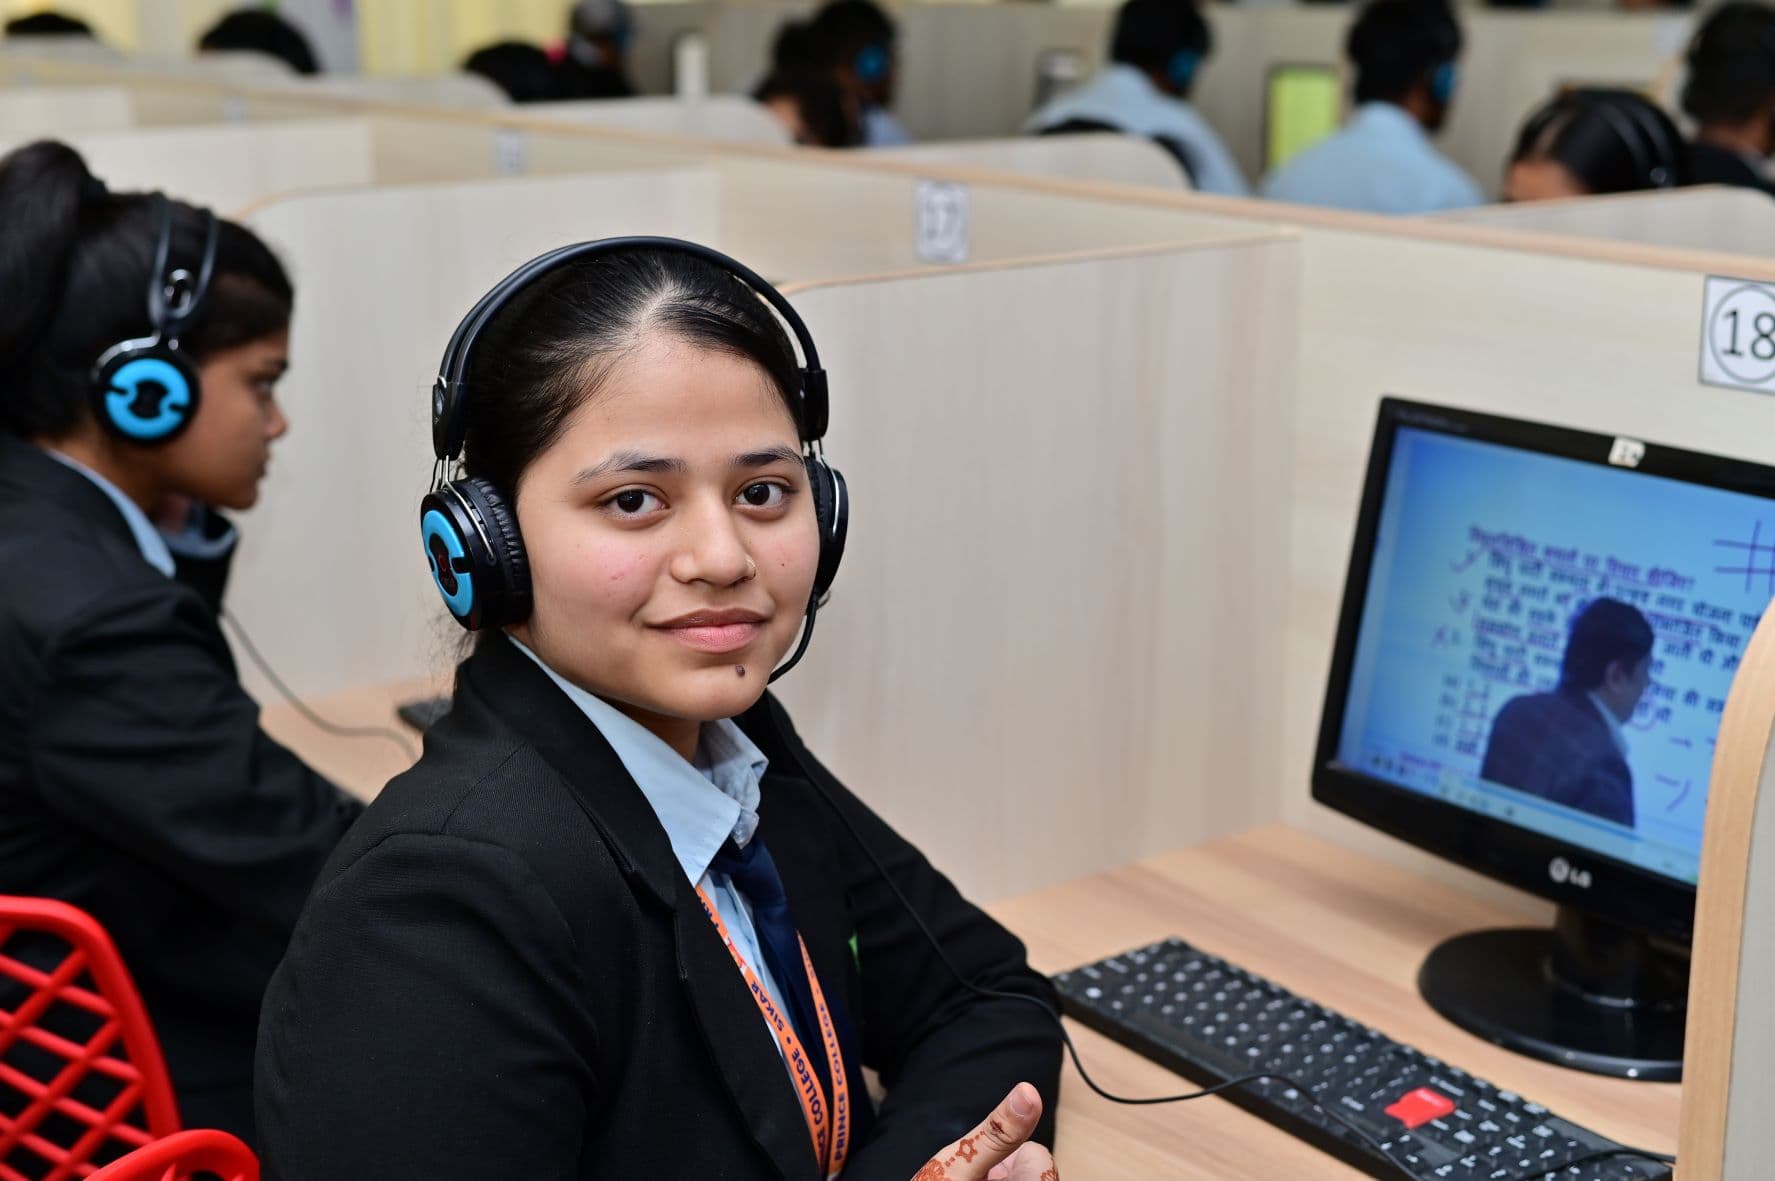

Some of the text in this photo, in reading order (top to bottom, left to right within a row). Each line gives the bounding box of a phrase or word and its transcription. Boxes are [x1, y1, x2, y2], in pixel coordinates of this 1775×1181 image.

[1723, 309, 1775, 361] 18
[751, 981, 823, 1125] COLLEGE SIKAR
[819, 1002, 847, 1162] PRINCE COLLEGE
